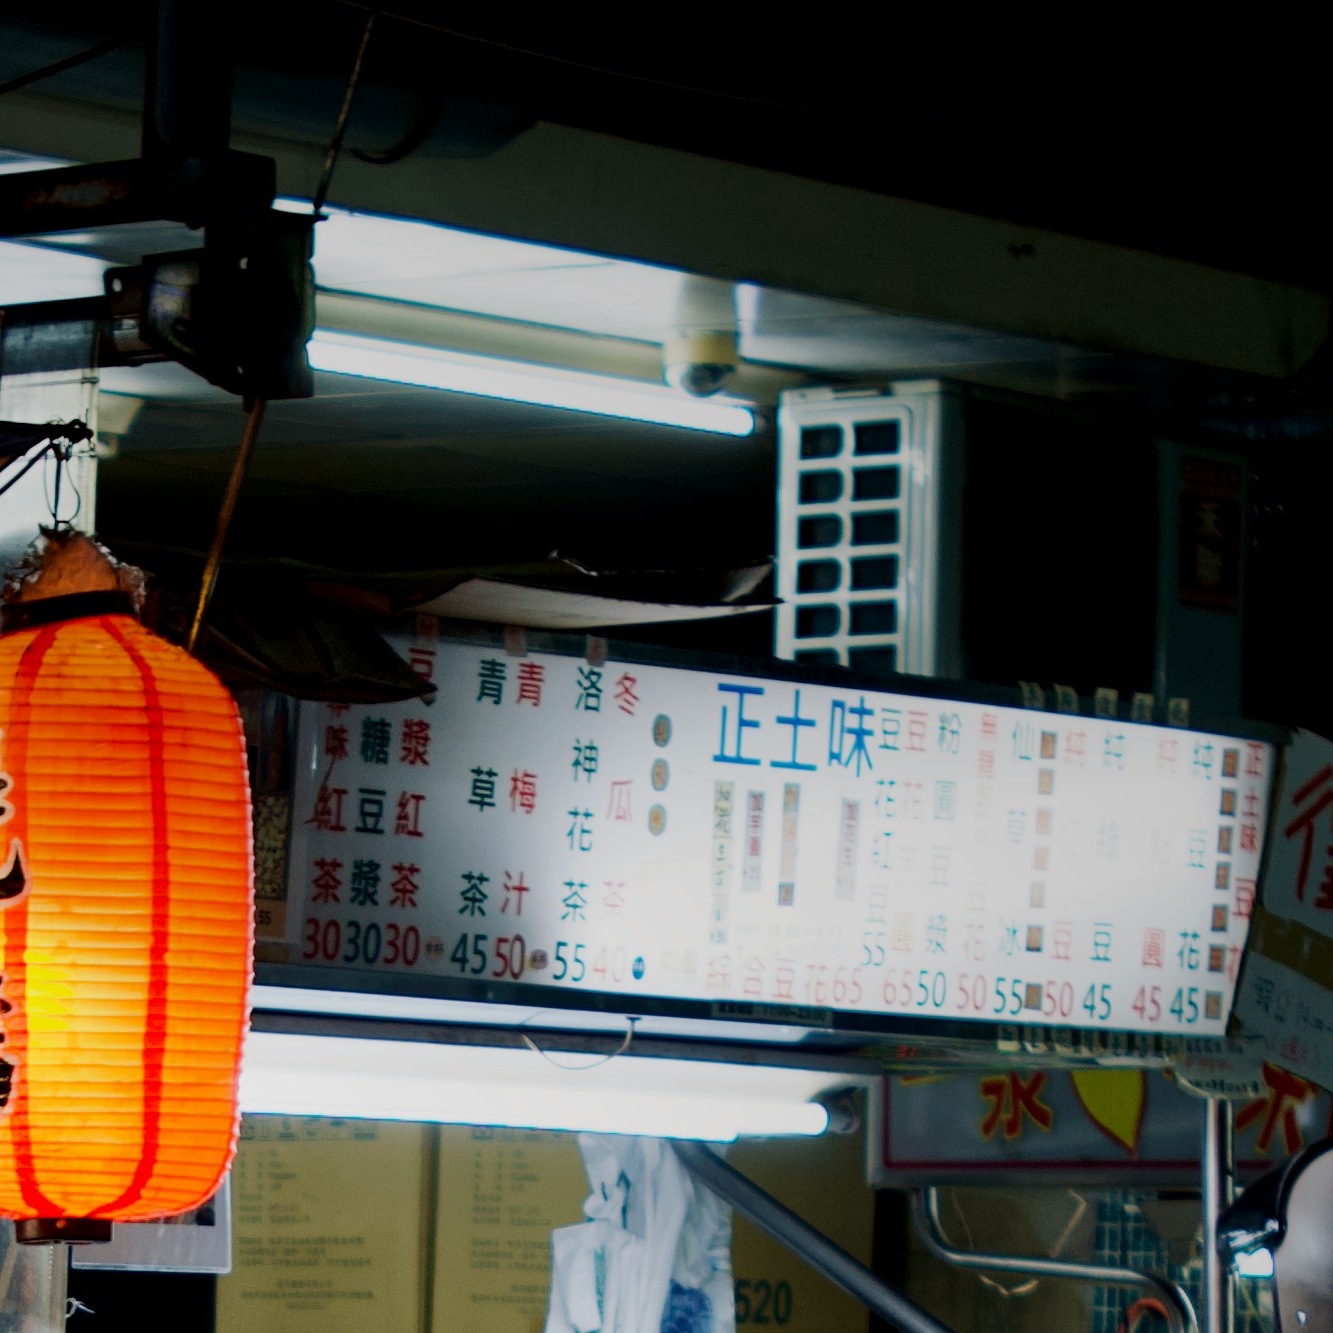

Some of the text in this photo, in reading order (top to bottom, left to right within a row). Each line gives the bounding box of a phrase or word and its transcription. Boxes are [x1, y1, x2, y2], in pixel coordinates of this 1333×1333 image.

[713, 683, 875, 778] 正土味
[460, 659, 507, 918] 青草茶
[500, 662, 545, 916] 青梅汁
[562, 667, 604, 923] 洛神花茶
[303, 919, 340, 961] 30
[343, 922, 381, 963] 30
[384, 925, 419, 966] 30
[451, 933, 487, 974] 45
[494, 936, 527, 980] 50
[553, 942, 587, 982] 55
[882, 970, 913, 1008] 65
[916, 971, 947, 1008] 50
[955, 972, 987, 1012] 50
[993, 977, 1025, 1015] 55
[1043, 981, 1074, 1018] 50
[1082, 982, 1113, 1021] 45
[1132, 983, 1163, 1022] 45
[1169, 986, 1201, 1024] 45
